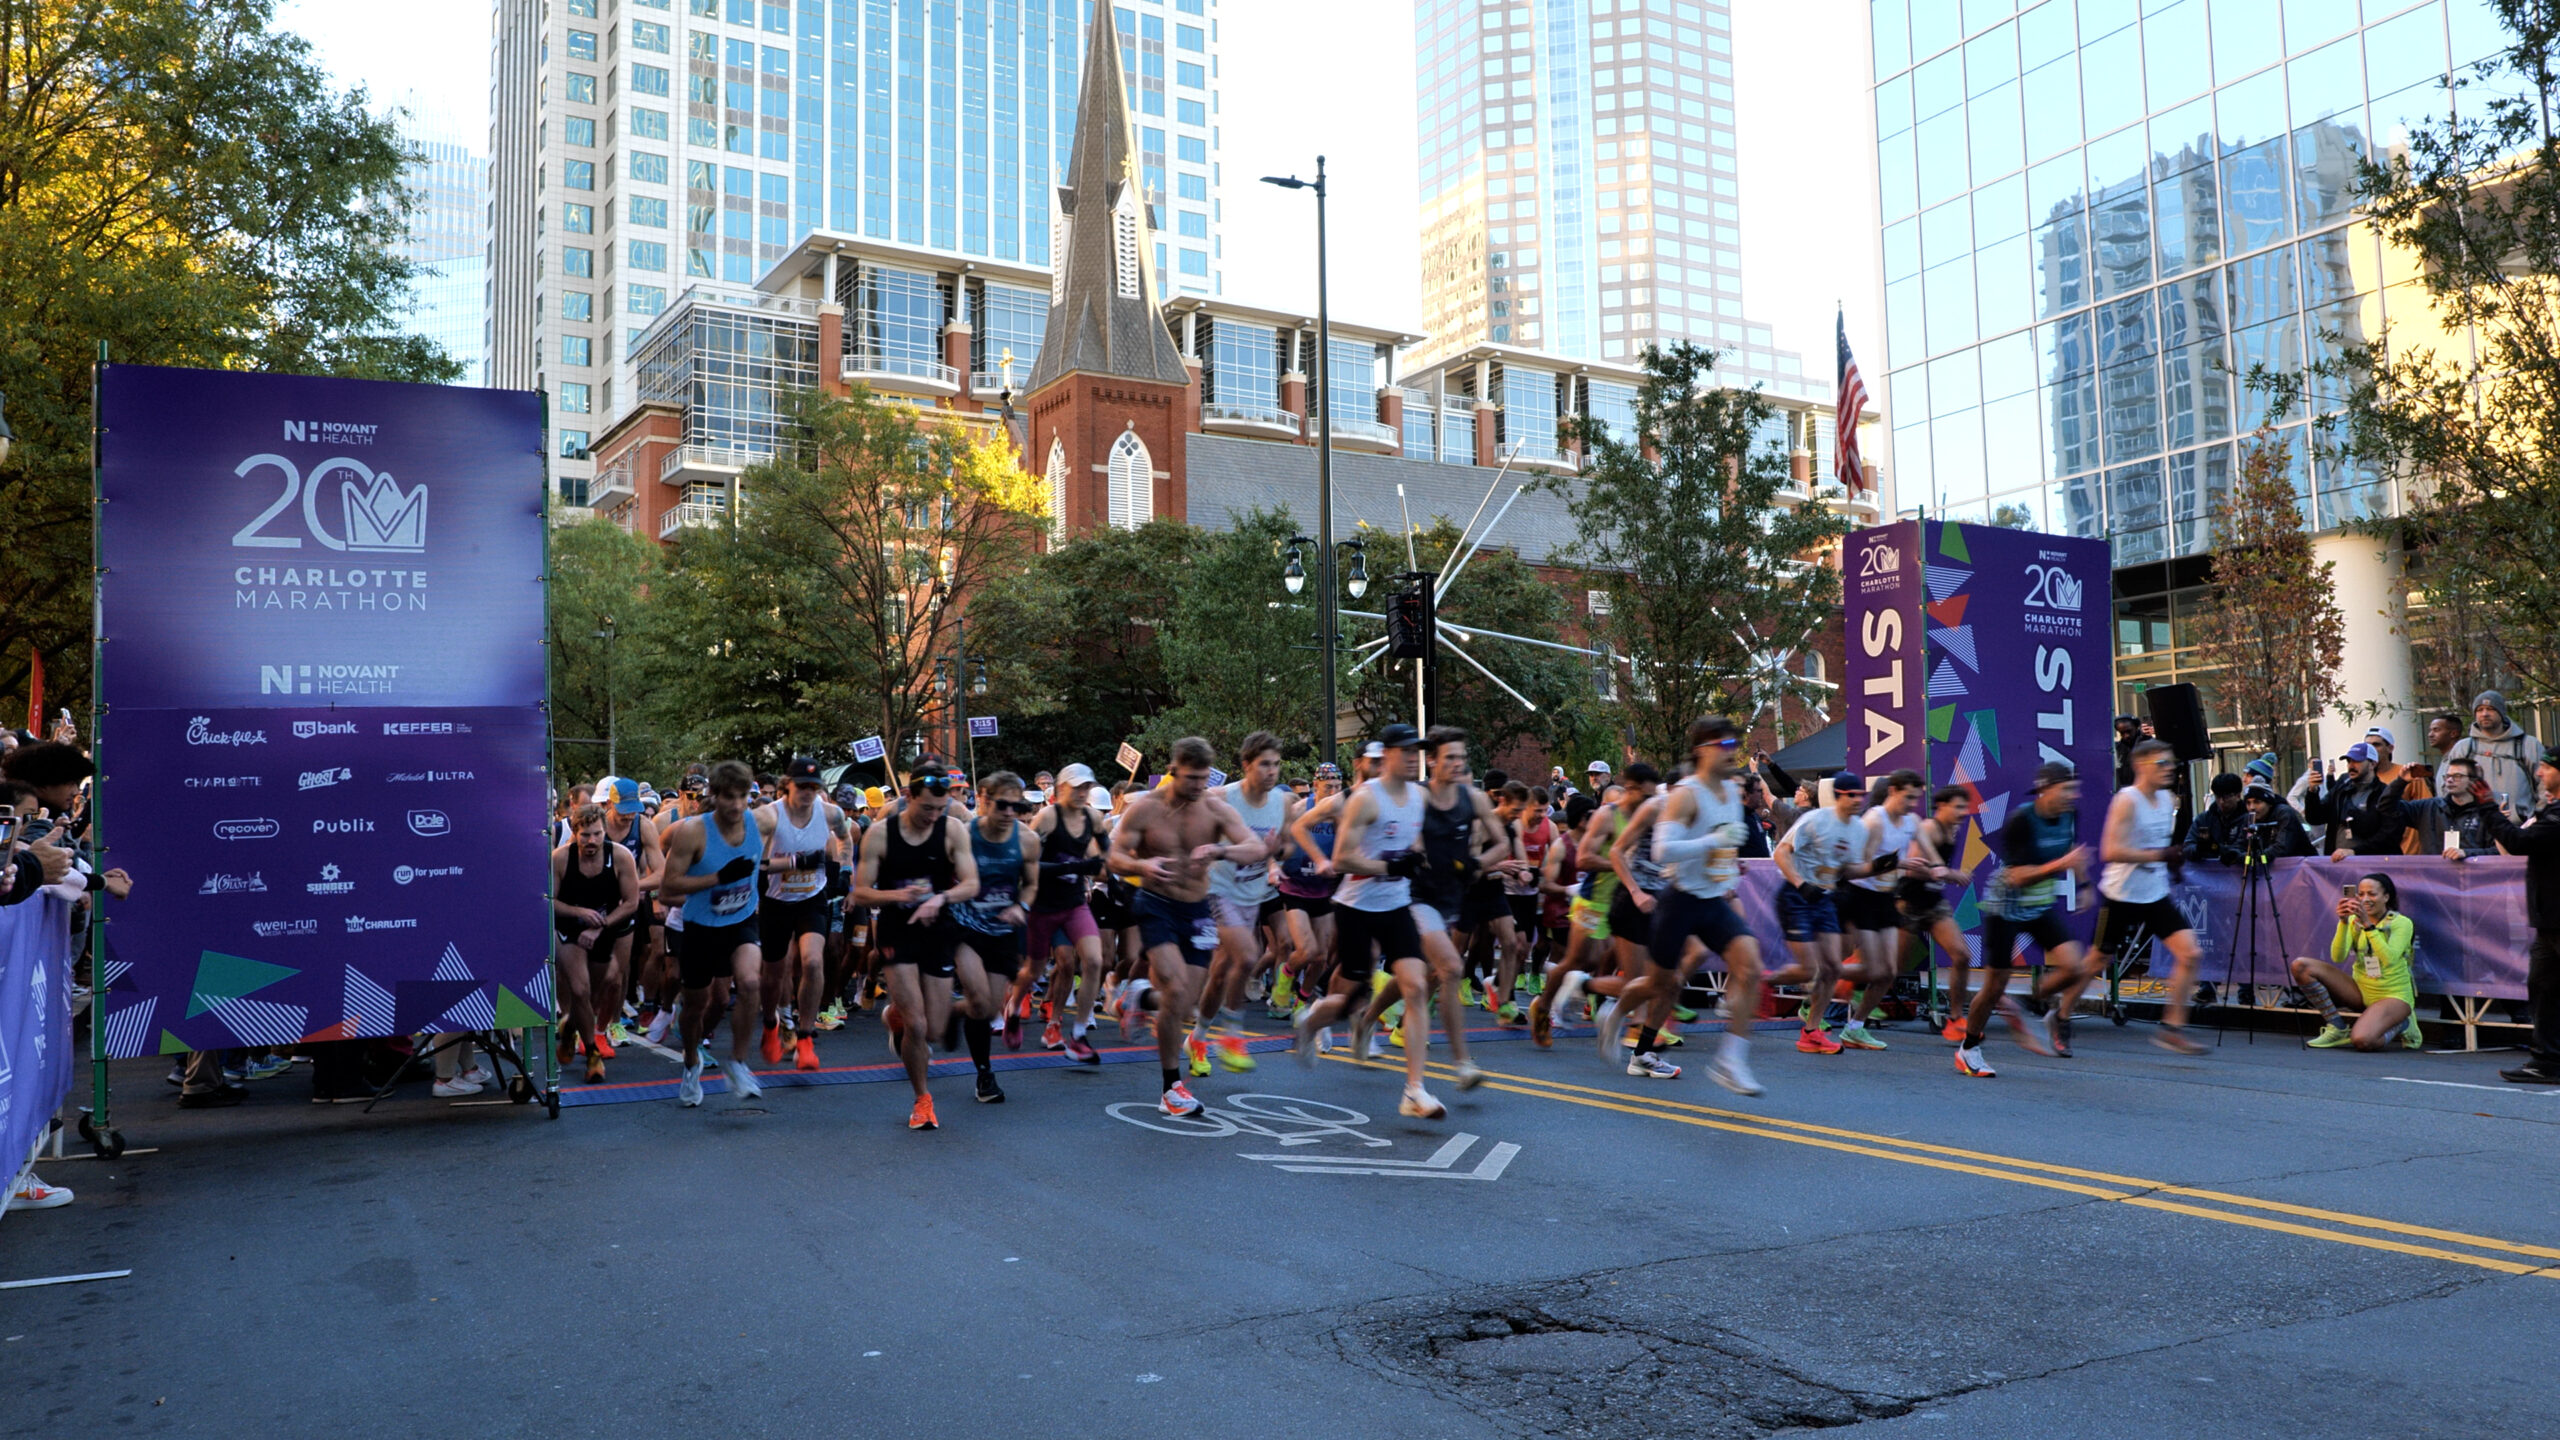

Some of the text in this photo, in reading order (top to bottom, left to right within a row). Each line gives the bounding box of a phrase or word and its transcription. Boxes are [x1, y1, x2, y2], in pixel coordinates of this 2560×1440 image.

[322, 422, 378, 434] NOVANT
[322, 433, 373, 445] HEALTH
[337, 470, 354, 481] TH
[234, 567, 427, 589] CHARLOTTE
[1860, 575, 1900, 588] CHARLOTTE
[1860, 582, 1900, 595] MARATHON
[235, 590, 427, 611] MARATHON
[2024, 613, 2082, 627] CHARLOTTE
[2024, 623, 2082, 637] MARATHON
[318, 665, 399, 679] NOVANT
[318, 680, 393, 694] HEALTH
[317, 720, 357, 735] bank
[383, 722, 453, 736] KEFFER
[298, 767, 341, 791] GHOST
[435, 771, 476, 781] ULTRA
[313, 818, 375, 834] Publix
[415, 814, 445, 828] Dole
[220, 824, 274, 834] recover
[415, 867, 428, 877] for
[429, 867, 449, 878] your
[449, 865, 464, 876] life
[306, 881, 355, 892] SUNBELT
[365, 919, 417, 930] CHARLOTTE
